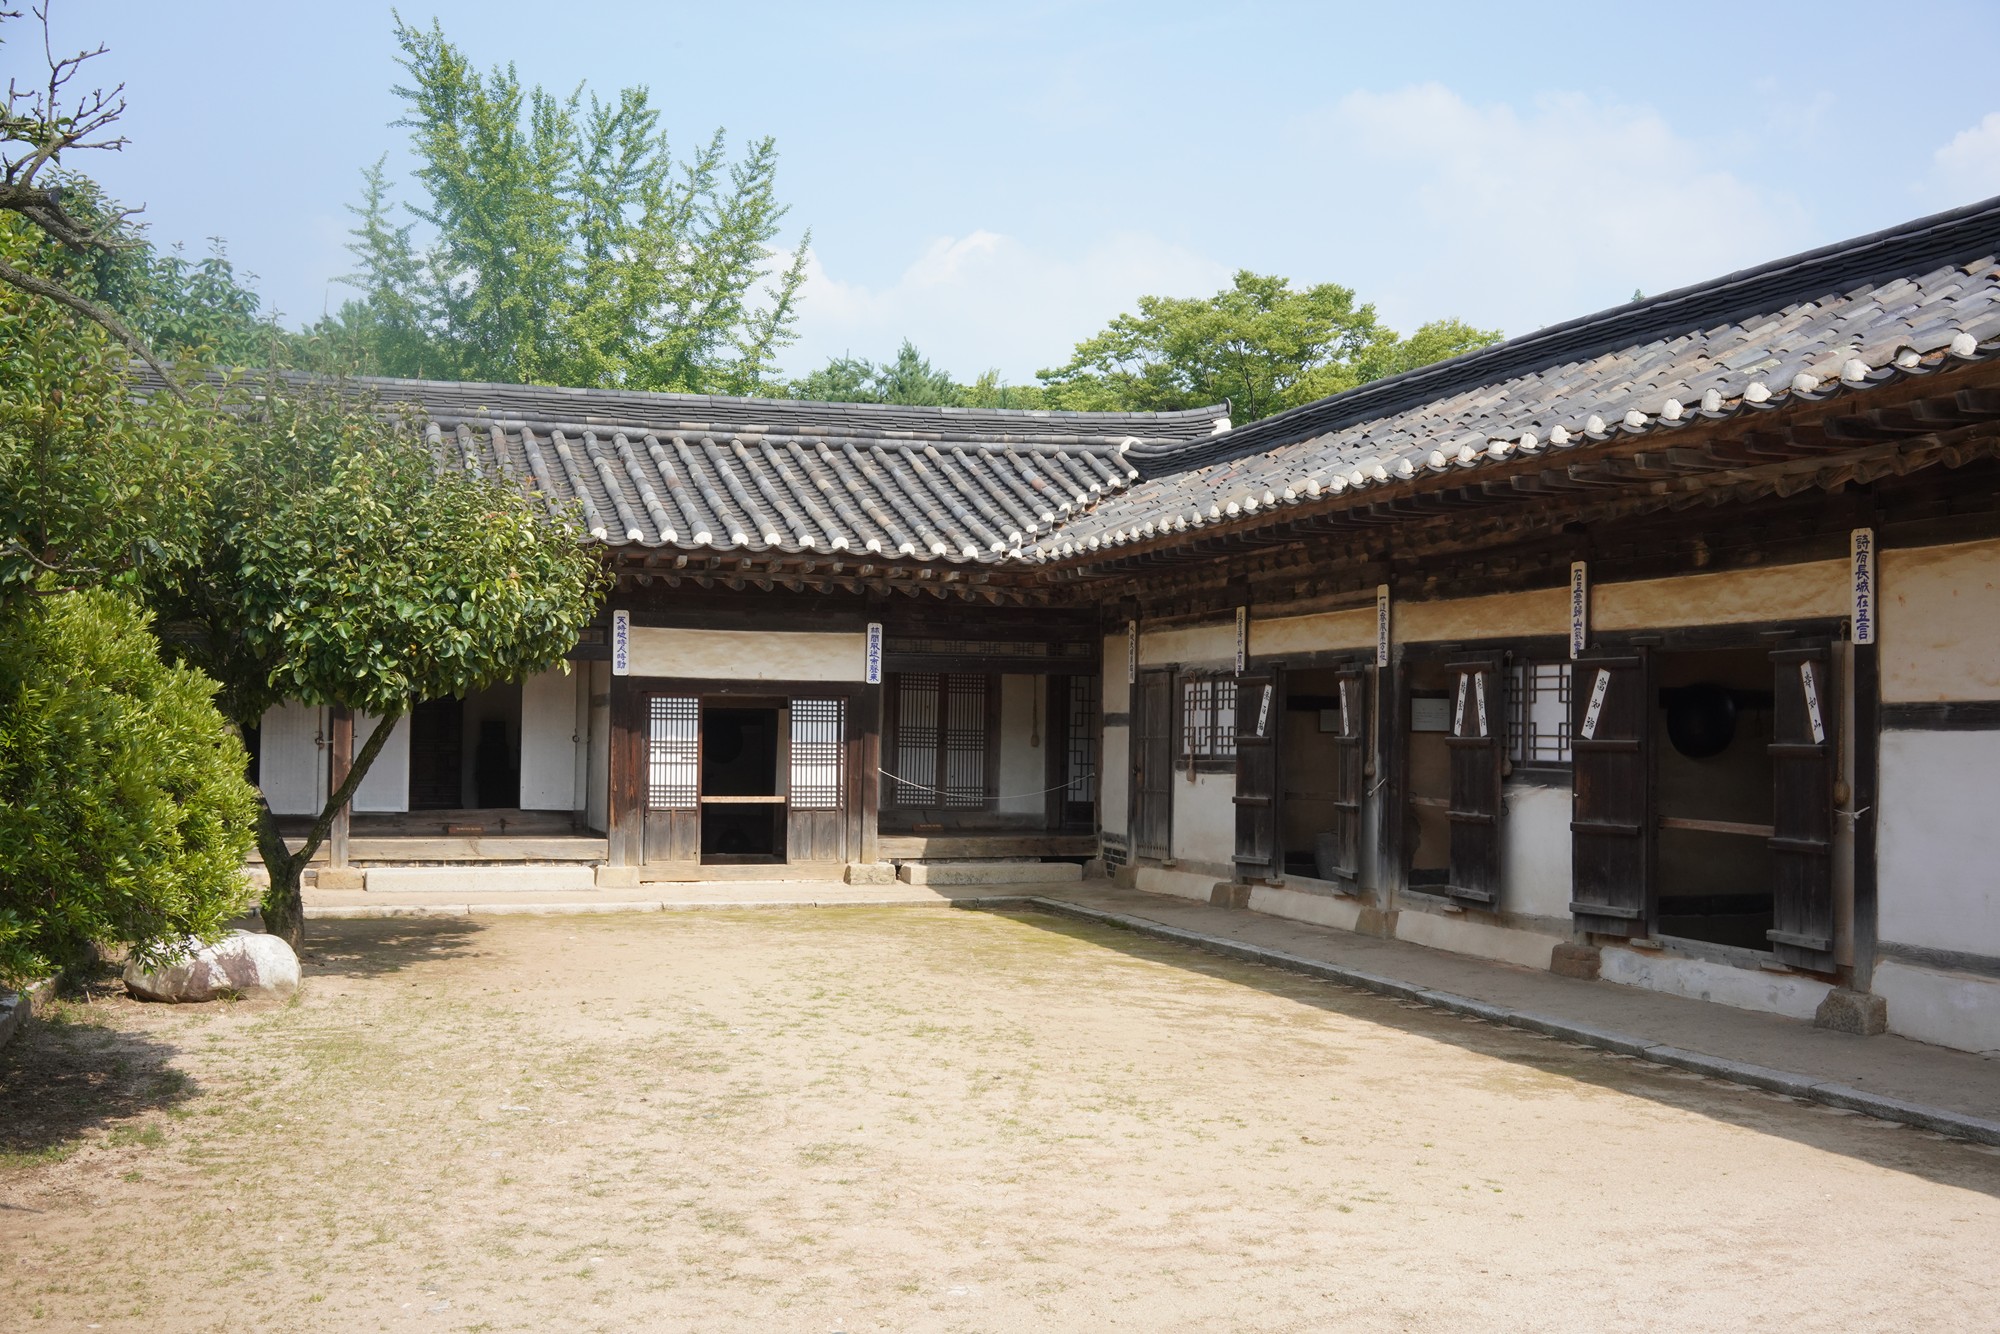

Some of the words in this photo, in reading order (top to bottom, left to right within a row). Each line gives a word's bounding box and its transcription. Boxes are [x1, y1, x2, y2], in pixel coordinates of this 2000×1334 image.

[1855, 534, 1871, 641] 詩有長城在五言
[1803, 671, 1822, 731] 壽如山
